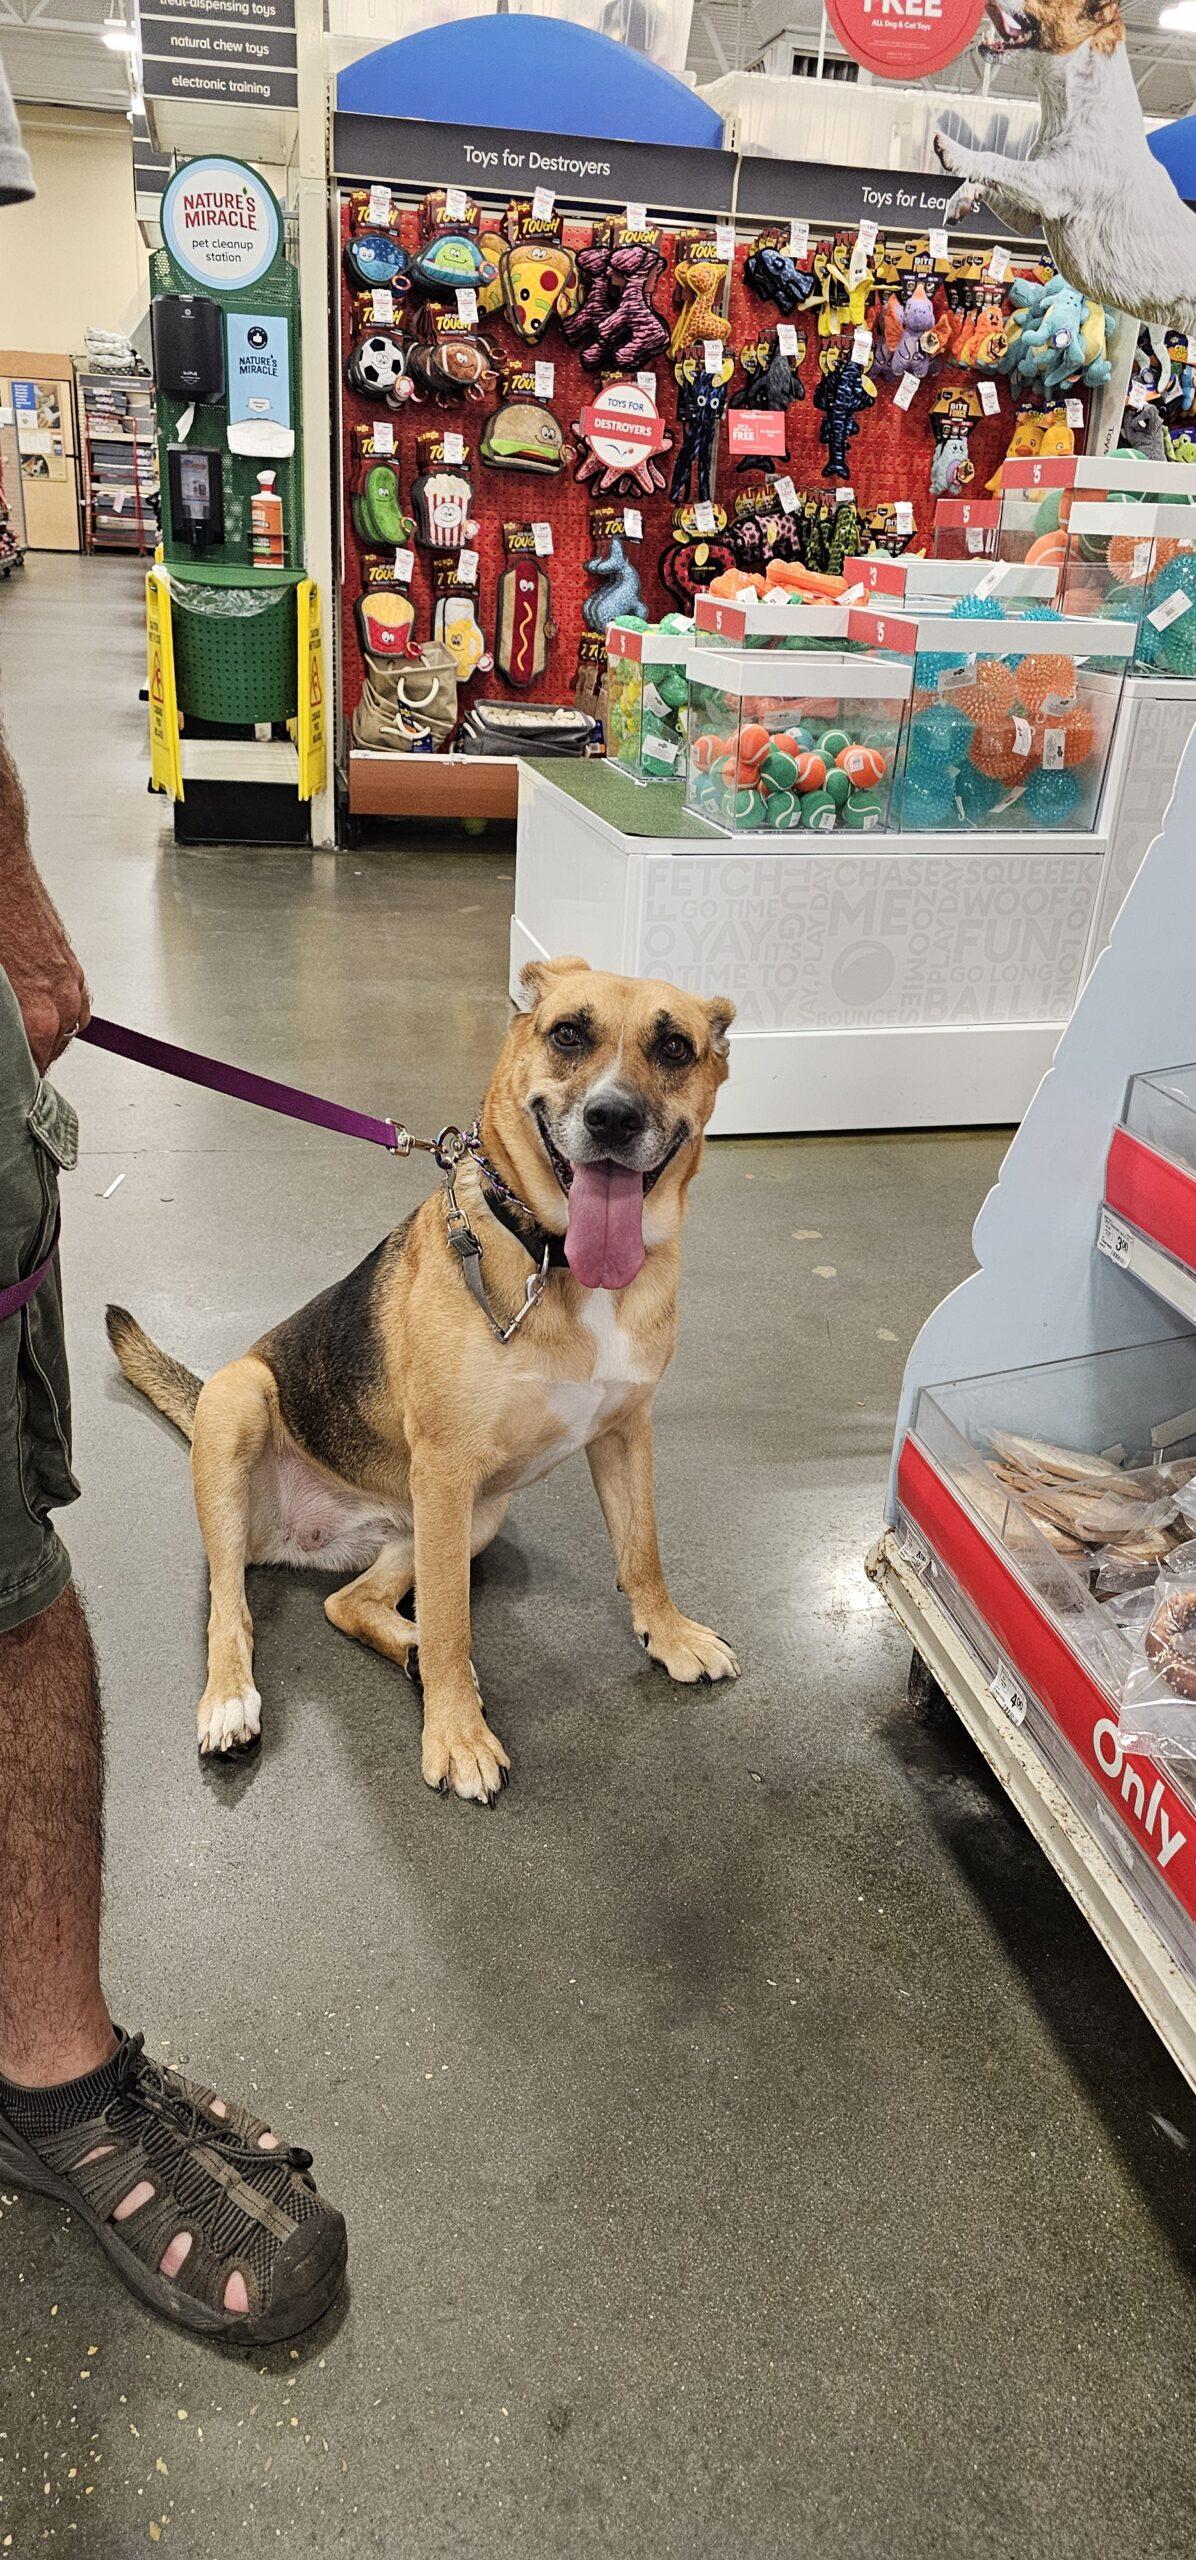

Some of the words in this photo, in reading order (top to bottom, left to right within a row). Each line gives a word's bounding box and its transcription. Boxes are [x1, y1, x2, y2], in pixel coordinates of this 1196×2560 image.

[252, 3, 276, 17] toys
[871, 19, 884, 27] ALL
[885, 20, 898, 29] Dog
[917, 22, 931, 32] Toys
[171, 37, 210, 49] natural
[213, 39, 243, 51] chew
[245, 43, 269, 57] toys
[172, 75, 226, 90] electronic
[229, 80, 270, 97] training
[463, 146, 498, 168] Toys
[502, 149, 525, 168] for
[528, 151, 610, 178] Destroyers
[183, 187, 256, 213] NATURE'S
[862, 186, 893, 208] Toys
[896, 189, 917, 207] for
[919, 192, 981, 213] Leas
[184, 210, 258, 231] MIRACLE
[522, 218, 560, 234] TOUGH
[192, 239, 208, 250] pet
[212, 239, 254, 251] cleanup
[618, 230, 660, 244] TOUGH
[206, 253, 241, 263] station
[690, 243, 718, 258] TOUG
[239, 355, 278, 368] NATURE'S
[239, 365, 279, 377] MIRACLE
[608, 397, 627, 408] TOYS
[629, 401, 644, 412] FOR
[594, 417, 653, 437] DESTROYERS
[732, 431, 755, 441] FREE
[646, 861, 783, 896] FETCH
[834, 860, 942, 887] CHASE
[965, 860, 1097, 886] SQUEEEK
[680, 899, 718, 919] GO
[725, 898, 779, 919] TIME
[963, 886, 1069, 917] WOOF
[827, 890, 912, 937] ME
[681, 920, 776, 963] YAY
[953, 918, 1064, 964] FUN
[764, 942, 802, 961] IT'S
[677, 963, 749, 989] TIME
[758, 962, 798, 989] TO
[950, 965, 984, 983] GO
[990, 963, 1053, 983] LONG
[1093, 1718, 1187, 1868] Only
